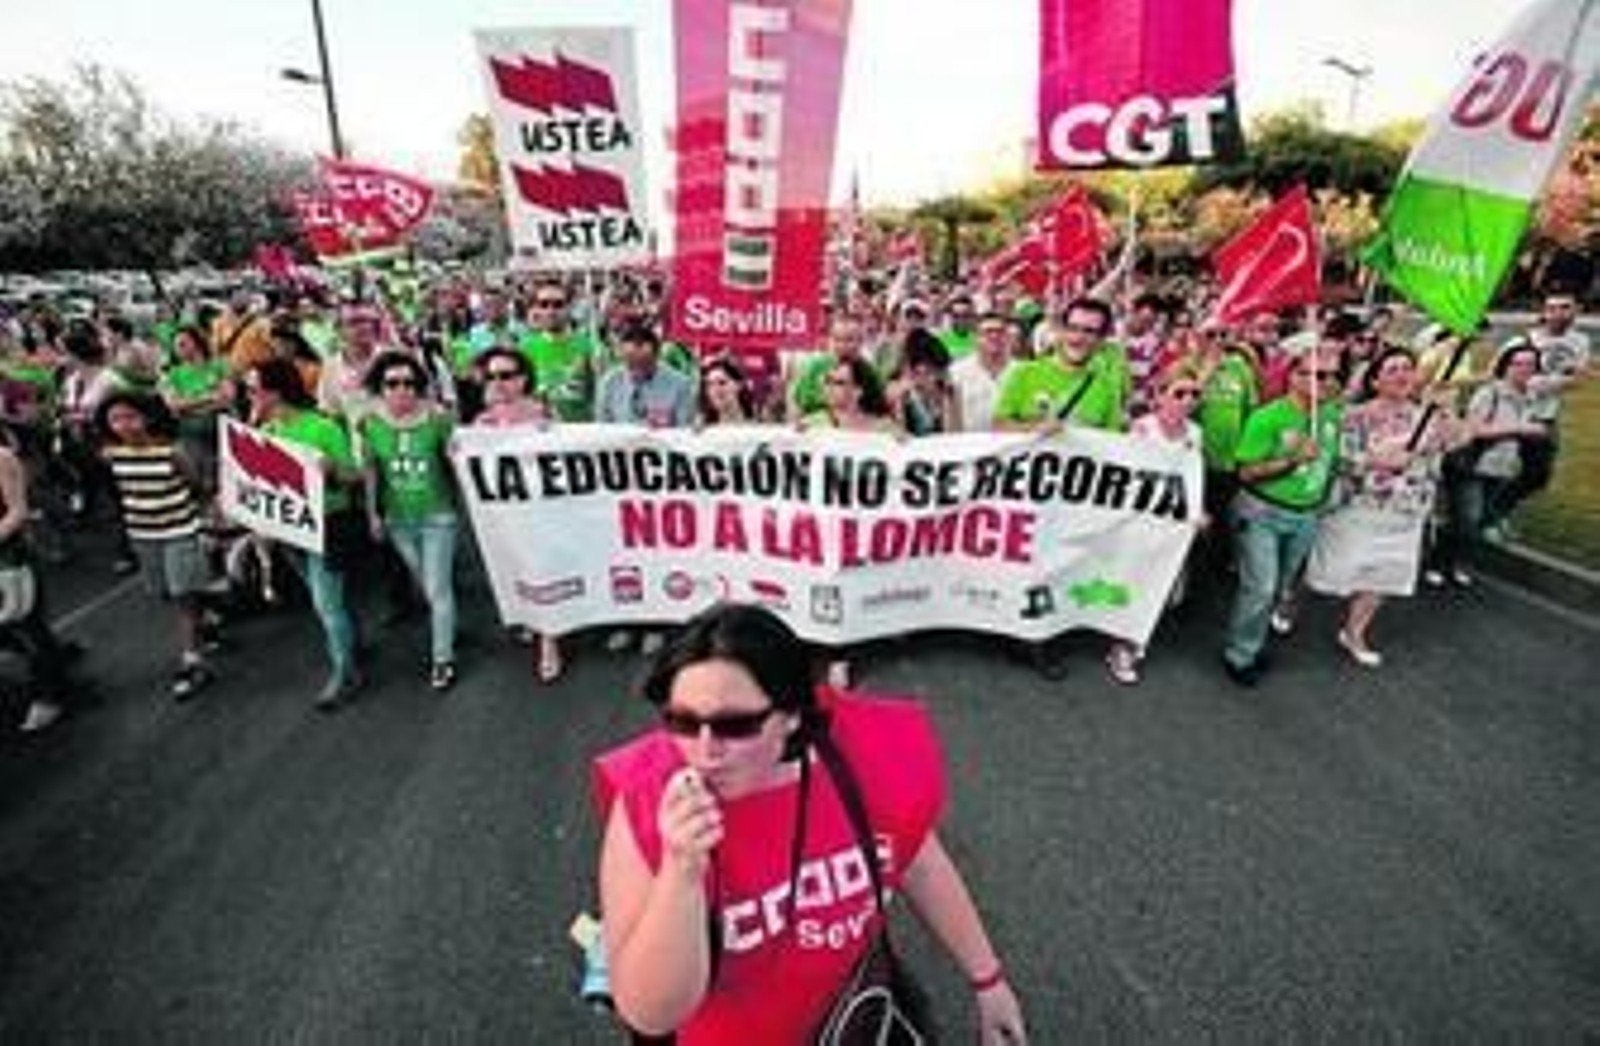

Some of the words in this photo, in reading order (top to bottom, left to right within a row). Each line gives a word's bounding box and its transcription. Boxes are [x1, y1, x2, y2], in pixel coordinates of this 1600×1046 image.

[521, 118, 633, 151] USTEA
[1050, 95, 1227, 165] CGT
[538, 217, 643, 248] USTEA
[684, 297, 807, 337] Sevilla
[467, 456, 529, 502] LA
[537, 442, 811, 501] EDUCACIÓN
[824, 453, 889, 509] NO
[904, 460, 966, 508] SE
[968, 451, 1189, 522] RECORTA
[619, 500, 697, 549] NO
[714, 503, 749, 552] A
[762, 510, 825, 566] LA
[840, 506, 1036, 568] LOMCE
